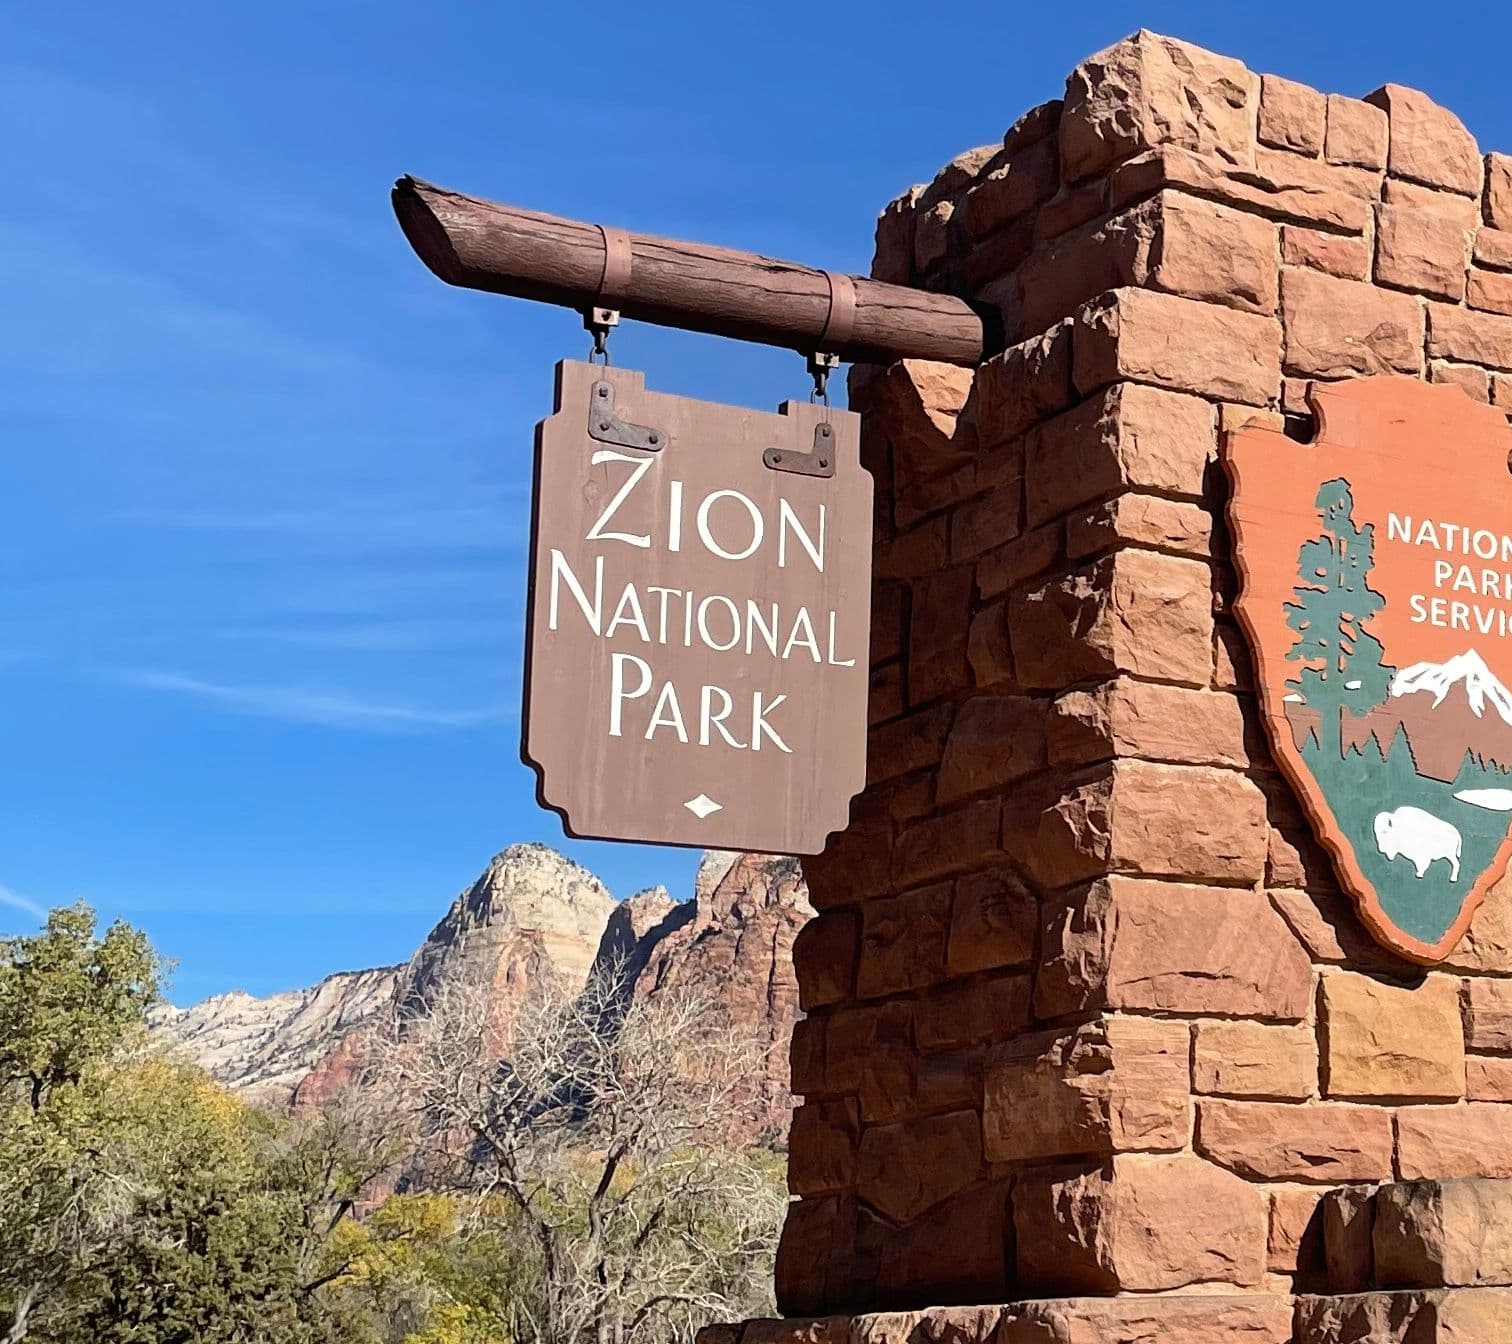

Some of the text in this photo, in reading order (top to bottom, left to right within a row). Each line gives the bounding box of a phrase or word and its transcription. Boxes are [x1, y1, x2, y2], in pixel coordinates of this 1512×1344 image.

[585, 450, 826, 573] ZION
[549, 548, 856, 667] NATIONAL
[608, 652, 793, 753] PARK
